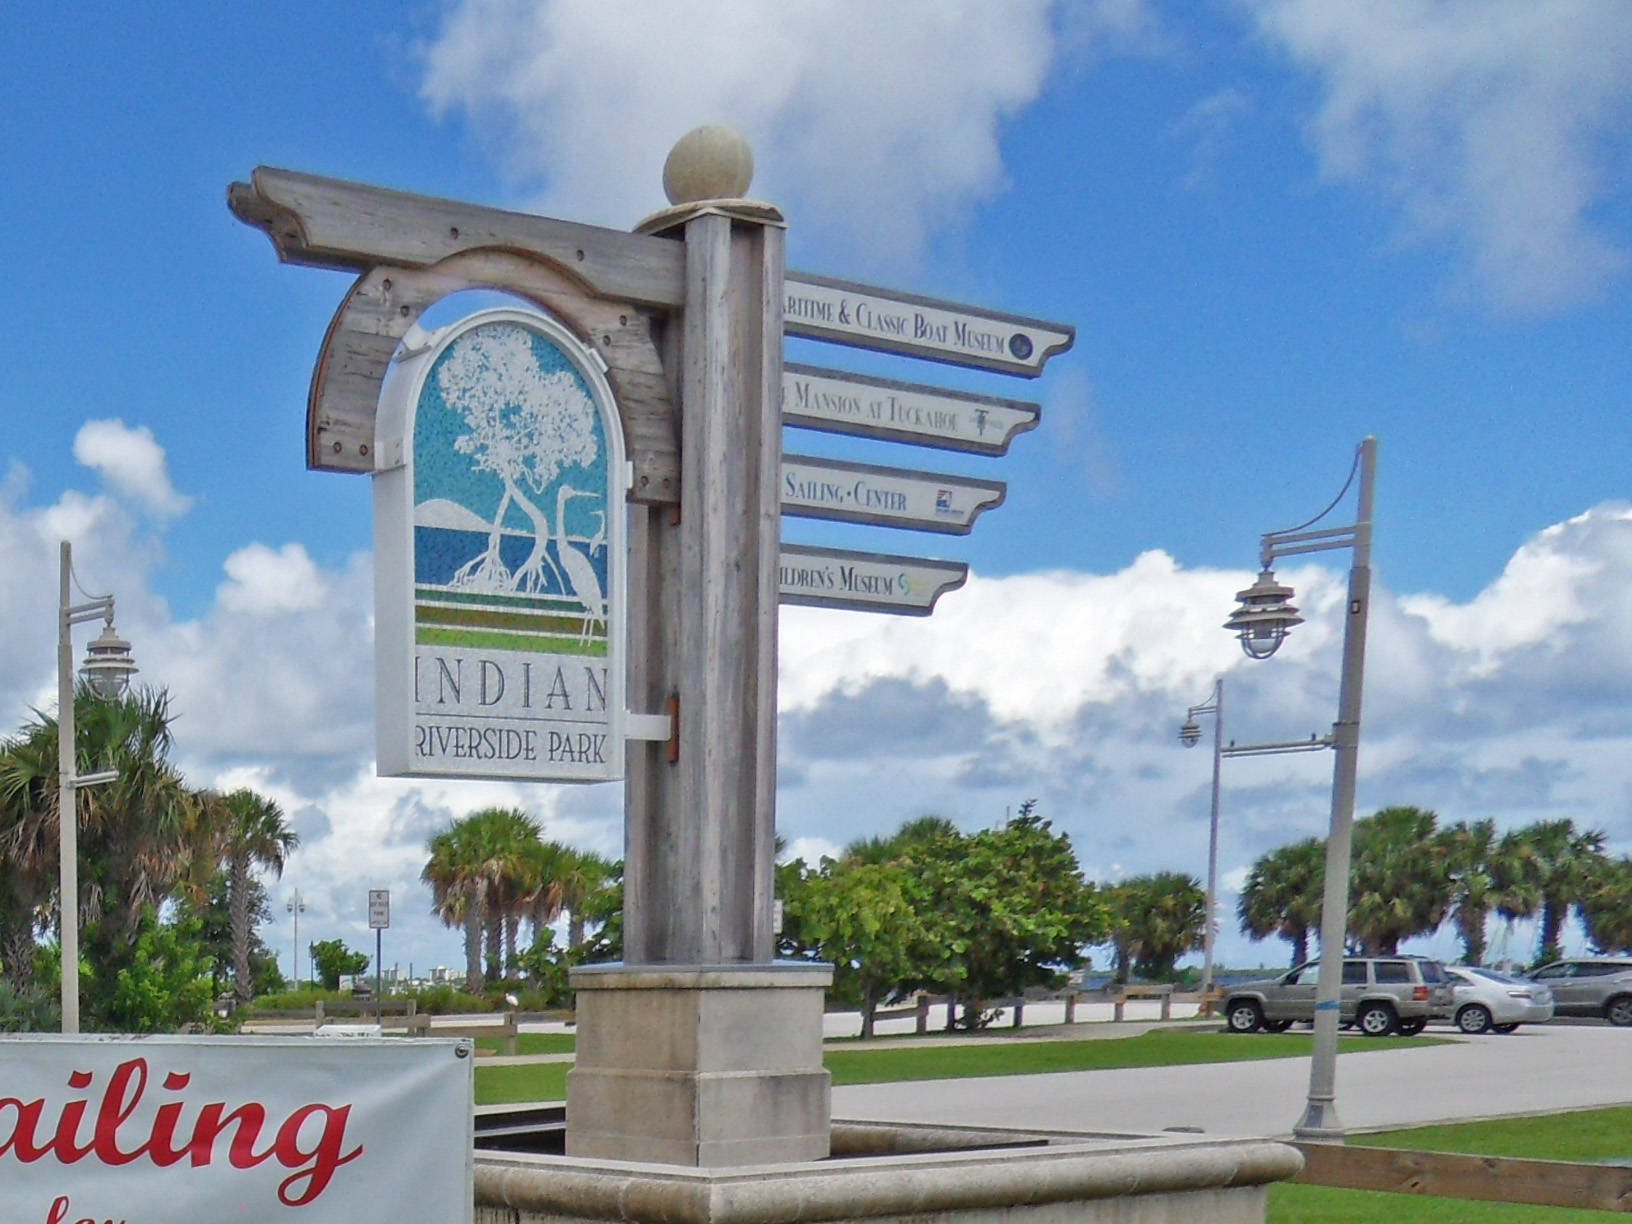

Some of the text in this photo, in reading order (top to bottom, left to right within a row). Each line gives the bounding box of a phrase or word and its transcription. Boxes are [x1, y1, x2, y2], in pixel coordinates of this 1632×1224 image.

[838, 298, 851, 326] &
[855, 302, 907, 336] CLASSIC
[914, 312, 948, 344] BOAT
[953, 320, 1005, 355] MUSEUM
[794, 381, 860, 415] MANSION
[779, 565, 894, 597] ILDREN'S MUSEUM
[415, 655, 608, 712] INDIAN
[415, 724, 608, 765] RIVERSIDE PARK
